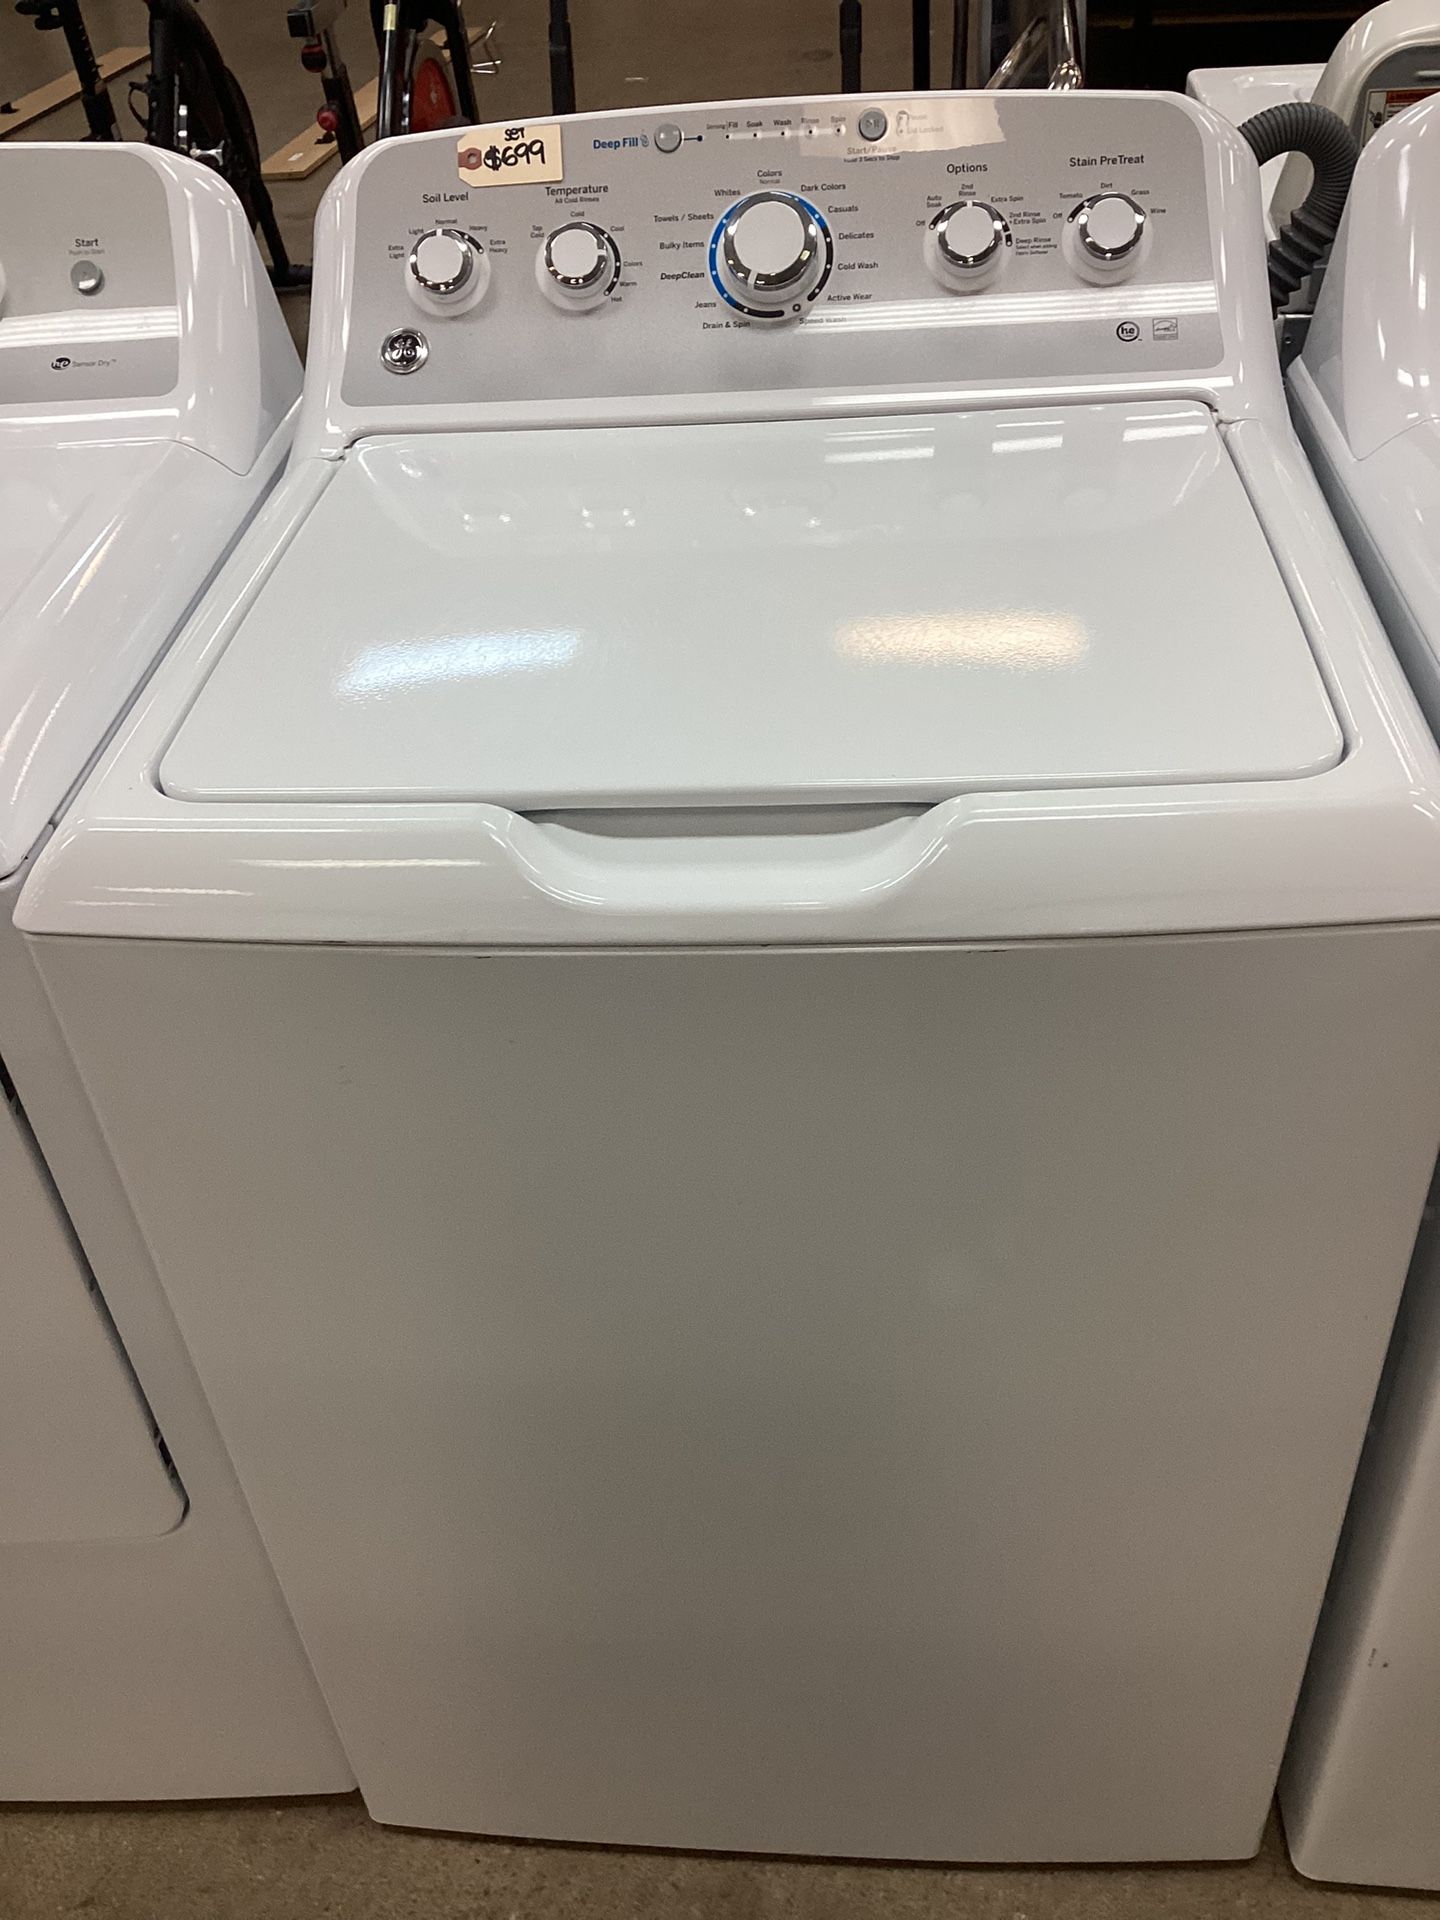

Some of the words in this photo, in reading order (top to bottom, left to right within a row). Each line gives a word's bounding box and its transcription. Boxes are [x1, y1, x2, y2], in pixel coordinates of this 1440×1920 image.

[504, 127, 525, 141] SET
[593, 138, 621, 150] Deep
[622, 136, 639, 147] Fill
[483, 139, 546, 171] $699
[1069, 156, 1098, 167] Stain
[1100, 154, 1145, 166] PreTreat
[757, 170, 783, 178] Colors
[946, 163, 988, 175] Options
[545, 184, 609, 197] Temperature
[714, 189, 741, 197] Whites
[801, 184, 819, 193] Dark
[821, 183, 846, 191] Colors
[422, 193, 441, 203] Soil
[443, 192, 469, 202] Level
[828, 205, 859, 214] Casuals
[654, 214, 680, 223] Towels
[688, 213, 714, 221] Sheets
[838, 232, 875, 241] Delicates
[75, 238, 99, 248] Start
[660, 241, 681, 251] Bulky
[682, 240, 705, 248] Items
[838, 262, 856, 270] Cold
[857, 261, 879, 269] Wash
[660, 271, 705, 281] DeepClean
[827, 295, 850, 303] Active
[852, 293, 872, 301] Wear
[695, 301, 717, 309] Jeans
[703, 322, 724, 330] Drain
[725, 321, 732, 329] &
[734, 320, 751, 329] Spin
